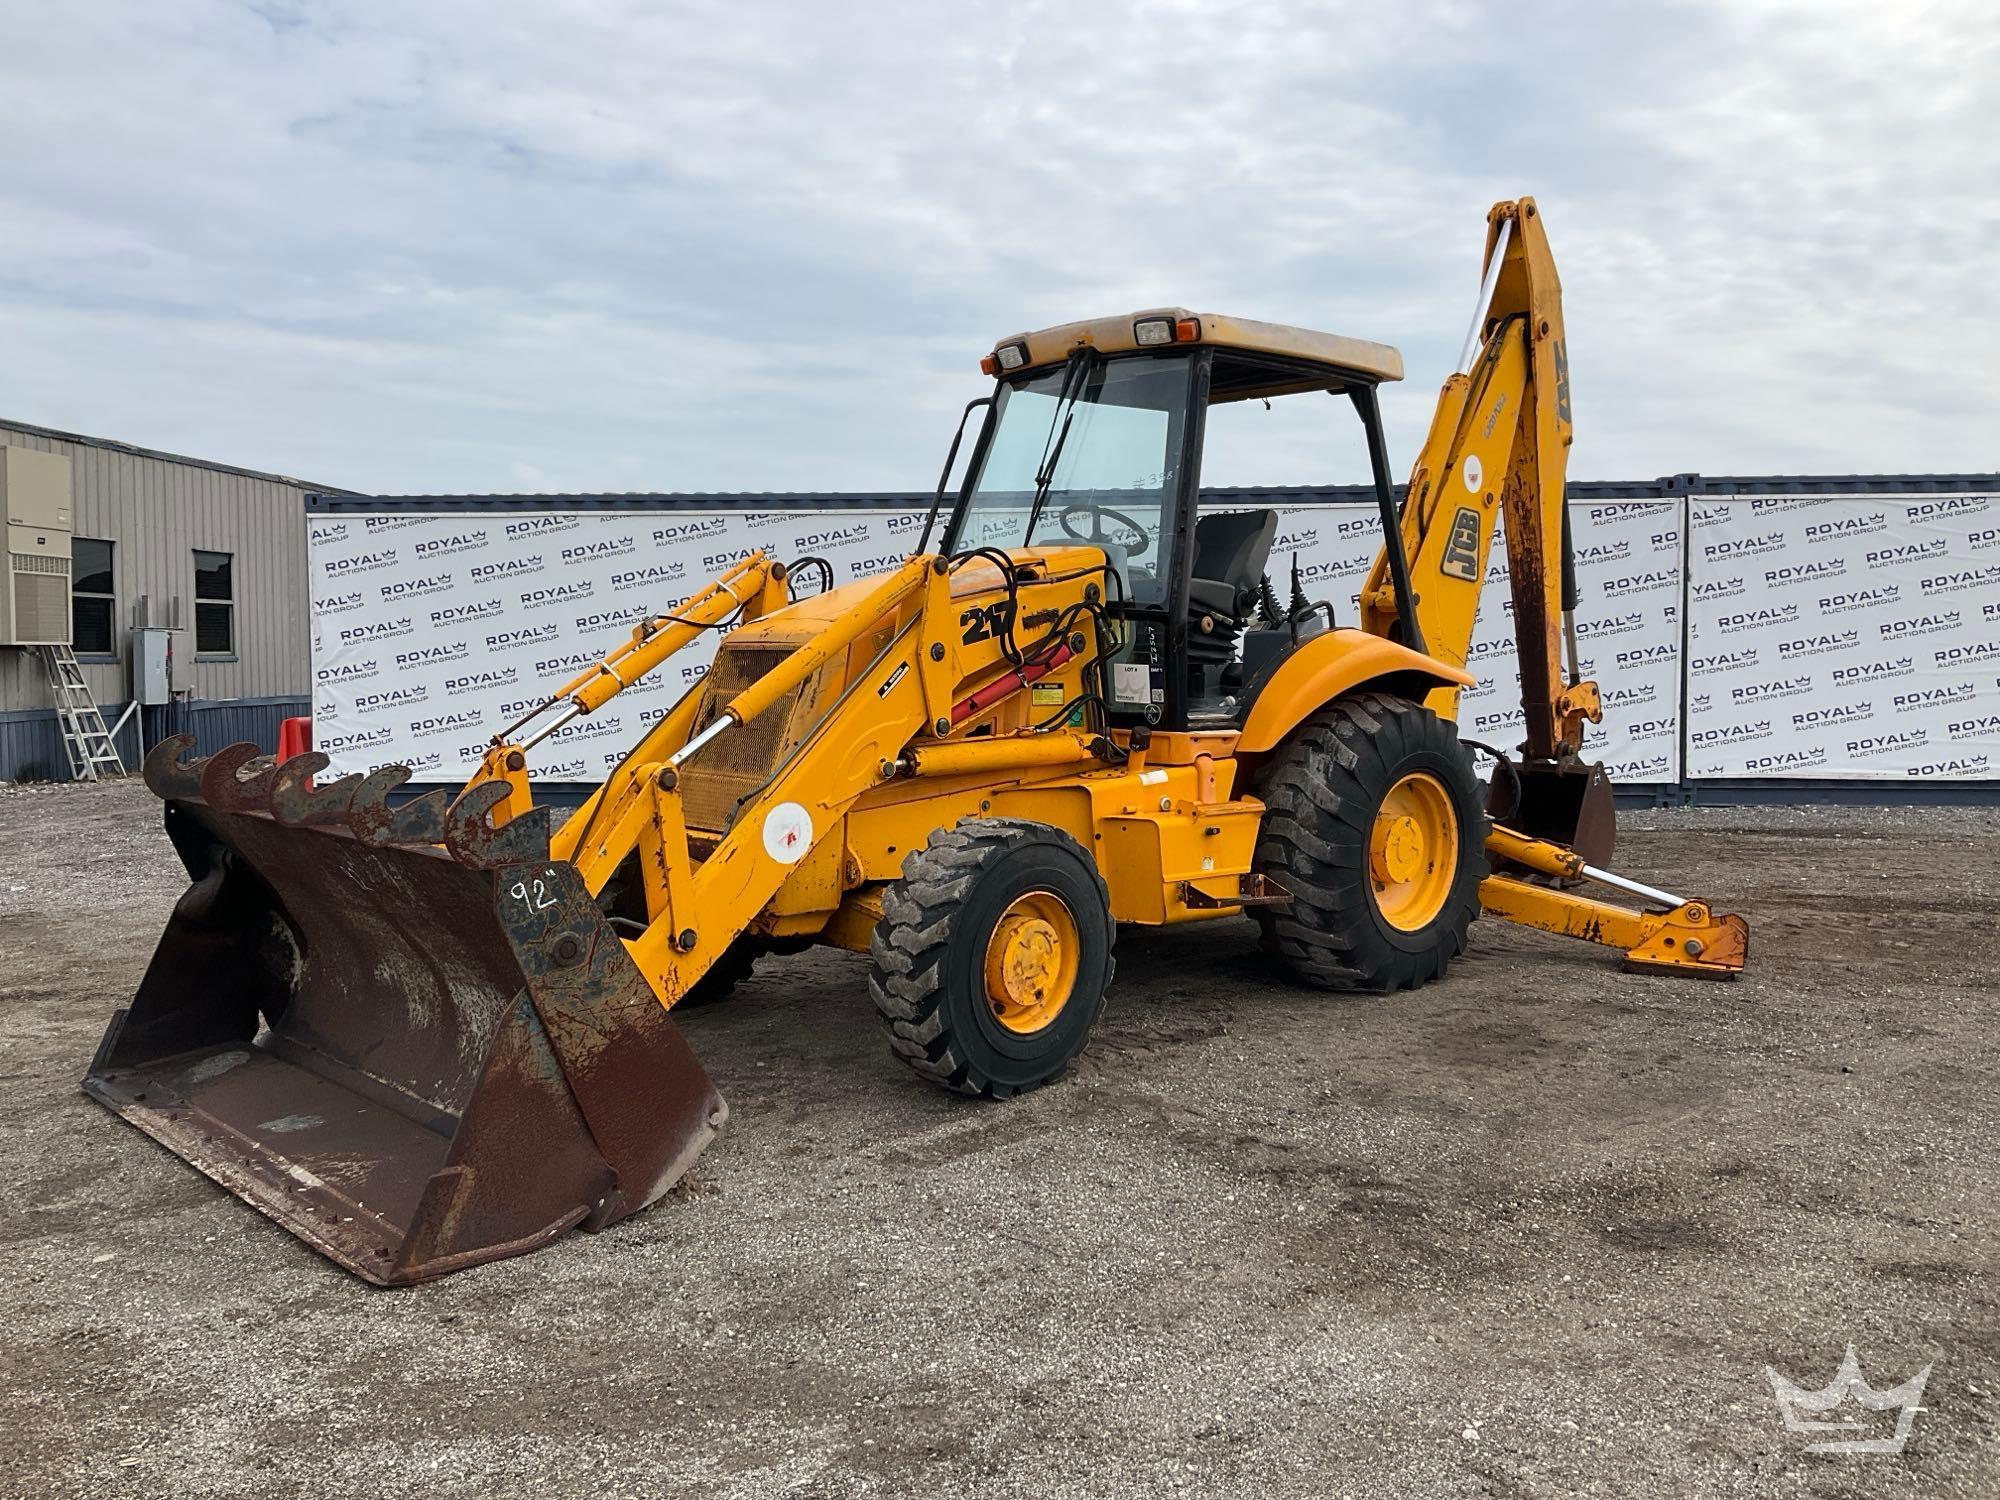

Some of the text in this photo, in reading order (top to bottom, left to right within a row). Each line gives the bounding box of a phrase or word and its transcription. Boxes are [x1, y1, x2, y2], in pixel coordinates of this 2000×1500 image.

[1593, 506, 1672, 526] AUCTION GROUP
[1754, 504, 1798, 517] AUCTION
[1907, 498, 1971, 517] ROYAL
[1910, 505, 1990, 524] AUCTION GROUP
[368, 520, 406, 534] AUCTION
[505, 515, 563, 535] ROYAL
[653, 522, 710, 540] ROYAL
[747, 517, 786, 528] AUCTION
[1698, 517, 1732, 528] GROUP
[1805, 518, 1869, 536] ROYAL
[319, 535, 349, 546] GROUP
[508, 522, 580, 542] AUCTION GROUP
[656, 528, 728, 547] AUCTION GROUP
[794, 529, 855, 547] ROYAL
[1808, 524, 1887, 544] AUCTION GROUP
[415, 535, 472, 553] ROYAL
[418, 541, 489, 560] AUCTION GROUP
[561, 541, 619, 559] ROYAL
[798, 535, 870, 554] AUCTION GROUP
[1286, 540, 1319, 552] GROUP
[1447, 512, 1478, 576] JCB
[1704, 537, 1768, 556] ROYAL
[1707, 543, 1786, 563] AUCTION GROUP
[1866, 543, 1930, 563] ROYAL
[325, 554, 382, 572] ROYAL
[564, 547, 636, 565] AUCTION GROUP
[1597, 552, 1631, 563] GROUP
[1869, 550, 1949, 569] AUCTION GROUP
[328, 560, 399, 579] AUCTION GROUP
[471, 559, 528, 578] ROYAL
[474, 565, 545, 584] AUCTION GROUP
[611, 566, 669, 585] ROYAL
[854, 566, 893, 579] AUCTION
[1338, 566, 1371, 577] GROUP
[1765, 562, 1828, 581] ROYAL
[381, 578, 438, 596] ROYAL
[614, 573, 686, 592] AUCTION GROUP
[1603, 572, 1667, 591] ROYAL
[1768, 569, 1847, 589] AUCTION GROUP
[1920, 570, 1985, 589] ROYAL
[384, 584, 454, 603] AUCTION GROUP
[520, 585, 580, 603] ROYAL
[1606, 585, 1649, 599] AUCTION
[1712, 588, 1746, 599] GROUP
[1819, 589, 1883, 608] ROYAL
[1923, 584, 1967, 596] AUCTION
[333, 603, 364, 613] GROUP
[523, 591, 594, 610] AUCTION GROUP
[1822, 596, 1901, 616] AUCTION GROUP
[430, 603, 487, 622] ROYAL
[433, 609, 504, 628] AUCTION GROUP
[576, 609, 633, 627] ROYAL
[1718, 608, 1781, 627] ROYAL
[340, 622, 397, 640] ROYAL
[579, 622, 617, 634] AUCTION
[960, 600, 1010, 646] 217
[1610, 624, 1644, 635] GROUP
[1721, 615, 1800, 634] AUCTION GROUP
[1880, 615, 1944, 634] ROYAL
[1883, 622, 1963, 641] AUCTION GROUP
[343, 628, 414, 646] AUCTION GROUP
[486, 628, 543, 646] ROYAL
[489, 634, 559, 653] AUCTION GROUP
[1778, 634, 1842, 653] ROYAL
[396, 646, 455, 664] ROYAL
[1616, 644, 1677, 663] ROYAL
[1781, 641, 1860, 660] AUCTION GROUP
[1935, 643, 1999, 661] ROYAL
[399, 652, 469, 671] AUCTION GROUP
[535, 653, 592, 671] ROYAL
[1619, 657, 1662, 670] AUCTION
[1726, 660, 1759, 671] GROUP
[1832, 661, 1896, 680] ROYAL
[1937, 656, 1980, 669] AUCTION
[349, 670, 379, 681] GROUP
[445, 671, 502, 689] ROYAL
[538, 666, 577, 678] AUCTION
[1835, 668, 1915, 687] AUCTION GROUP
[448, 678, 519, 696] AUCTION GROUP
[633, 684, 664, 694] GROUP
[1462, 689, 1496, 700] GROUP
[1732, 680, 1795, 699] ROYAL
[355, 689, 412, 707] ROYAL
[358, 695, 429, 714] AUCTION GROUP
[1623, 695, 1656, 706] GROUP
[1734, 687, 1813, 706] AUCTION GROUP
[1893, 687, 1958, 706] ROYAL
[1896, 694, 1976, 713] AUCTION GROUP
[410, 713, 467, 732] ROYAL
[1792, 706, 1856, 724] ROYAL
[1795, 713, 1874, 731] AUCTION GROUP
[413, 720, 484, 738] AUCTION GROUP
[550, 722, 606, 738] ROYAL
[1478, 721, 1520, 733] AUCTION
[1631, 729, 1675, 742] AUCTION
[1691, 724, 1755, 743] ROYAL
[1951, 728, 1995, 740] AUCTION
[320, 732, 377, 750] ROYAL
[362, 738, 394, 748] GROUP
[552, 727, 623, 746] AUCTION GROUP
[1694, 731, 1773, 750] AUCTION GROUP
[1846, 733, 1910, 752] ROYAL
[1849, 740, 1929, 759] AUCTION GROUP
[1746, 751, 1809, 770] ROYAL
[1794, 758, 1827, 769] GROUP
[1908, 760, 1972, 776] ROYAL
[1636, 768, 1670, 778] GROUP
